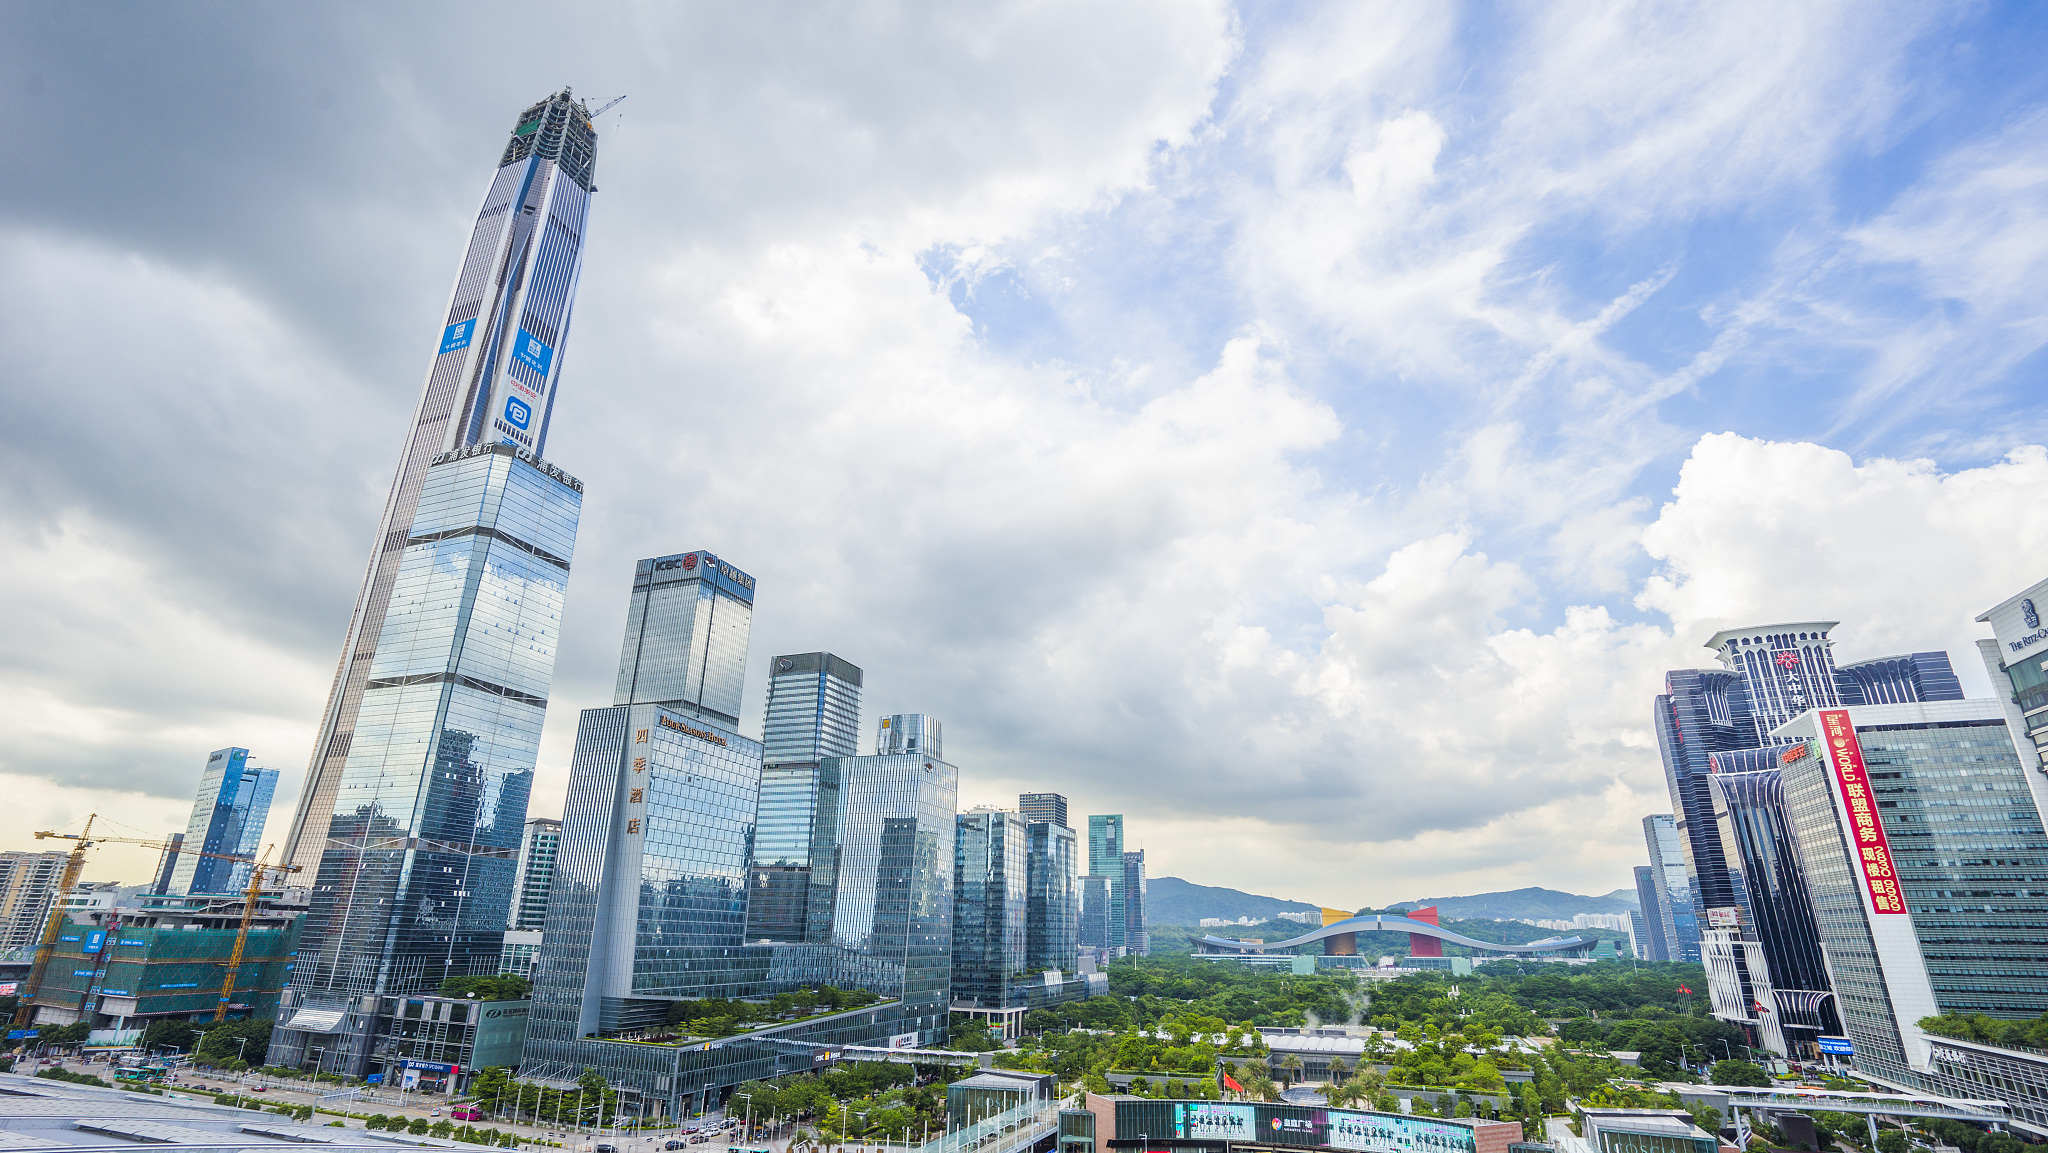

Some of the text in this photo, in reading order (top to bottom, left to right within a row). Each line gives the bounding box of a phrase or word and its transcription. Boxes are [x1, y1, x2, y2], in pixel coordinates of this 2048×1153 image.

[448, 441, 495, 462] 浦发银行
[536, 457, 582, 492] 浦发银行
[655, 559, 681, 571] ICBC
[2008, 641, 2024, 651] THE
[1785, 670, 1806, 707] 大中华
[662, 715, 728, 746] FOUR SEASONS HOTEL
[1825, 714, 1843, 737] 星河
[627, 728, 649, 834] 四季酒店
[1835, 748, 1856, 782] WORLD
[1845, 783, 1877, 842] 联盟商务
[1861, 847, 1891, 911] 现楼租售
[1873, 845, 1901, 911] 2830 9999
